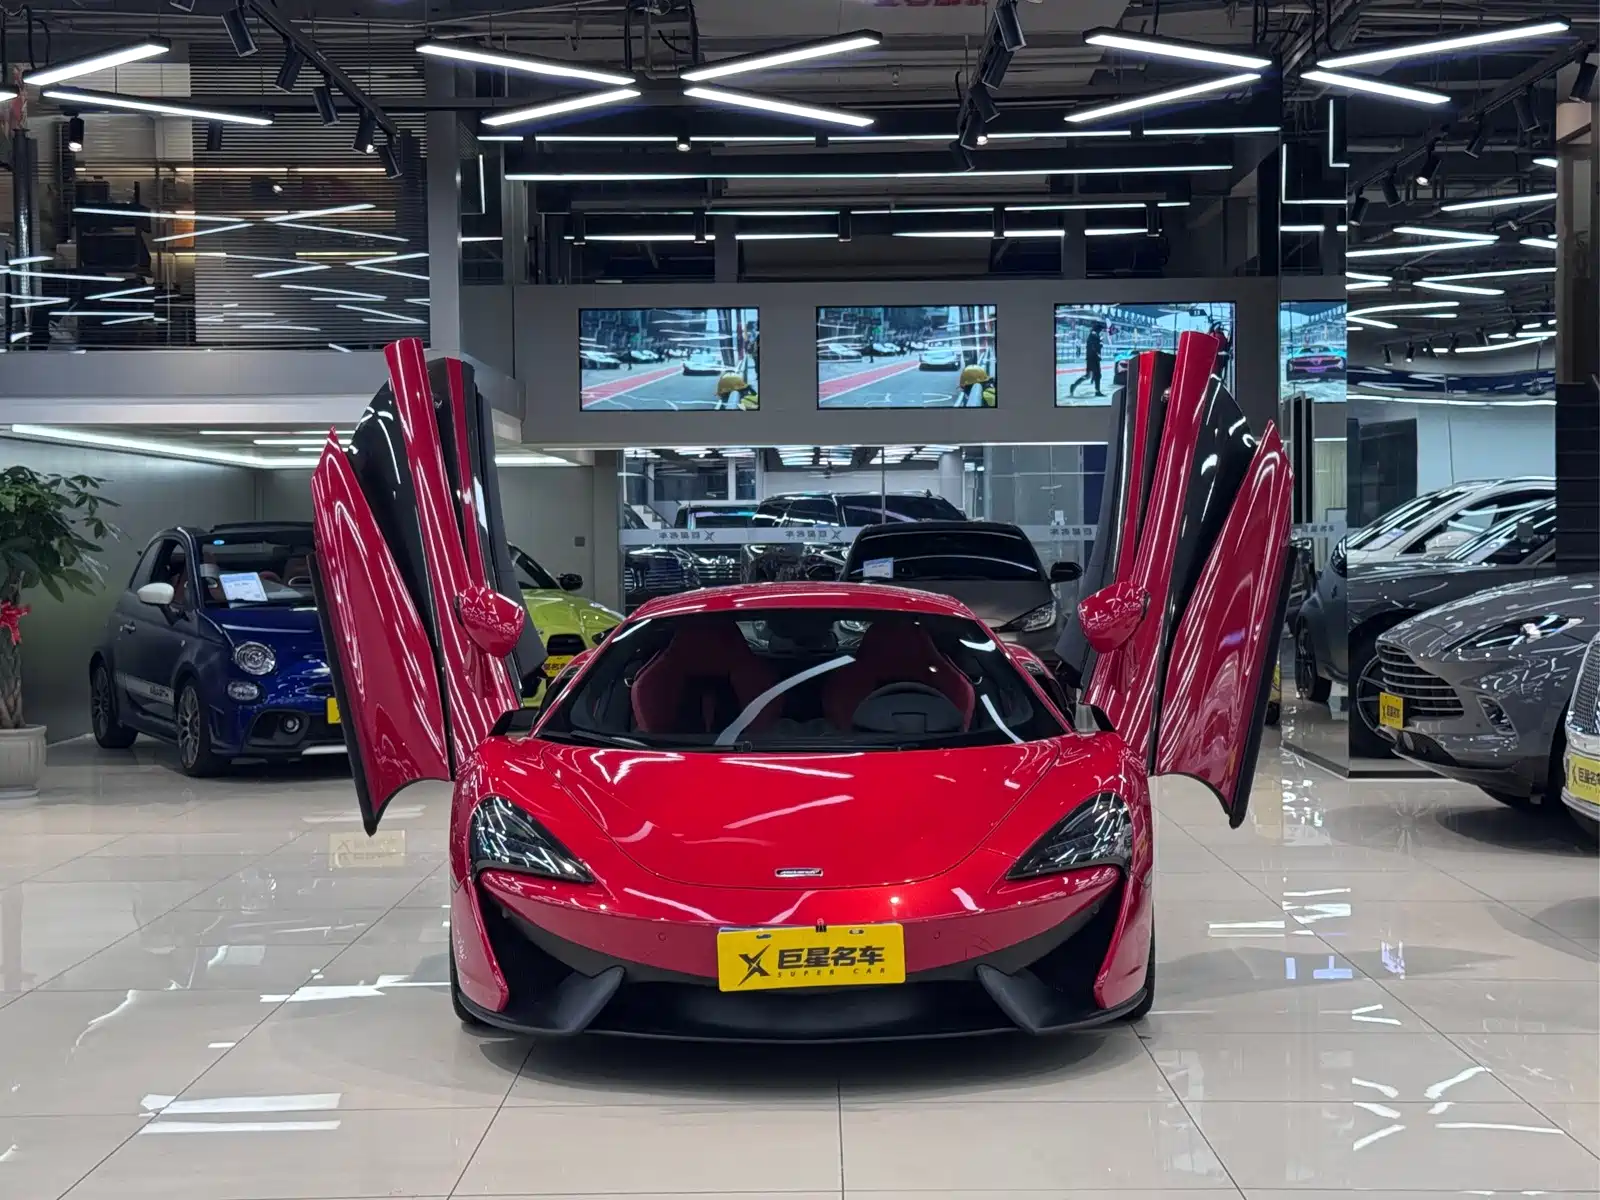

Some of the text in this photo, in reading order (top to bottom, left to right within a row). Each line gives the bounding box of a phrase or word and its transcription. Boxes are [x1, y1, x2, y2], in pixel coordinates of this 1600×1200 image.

[778, 945, 885, 969] 巨星名车
[778, 967, 885, 978] SUPER CAR
